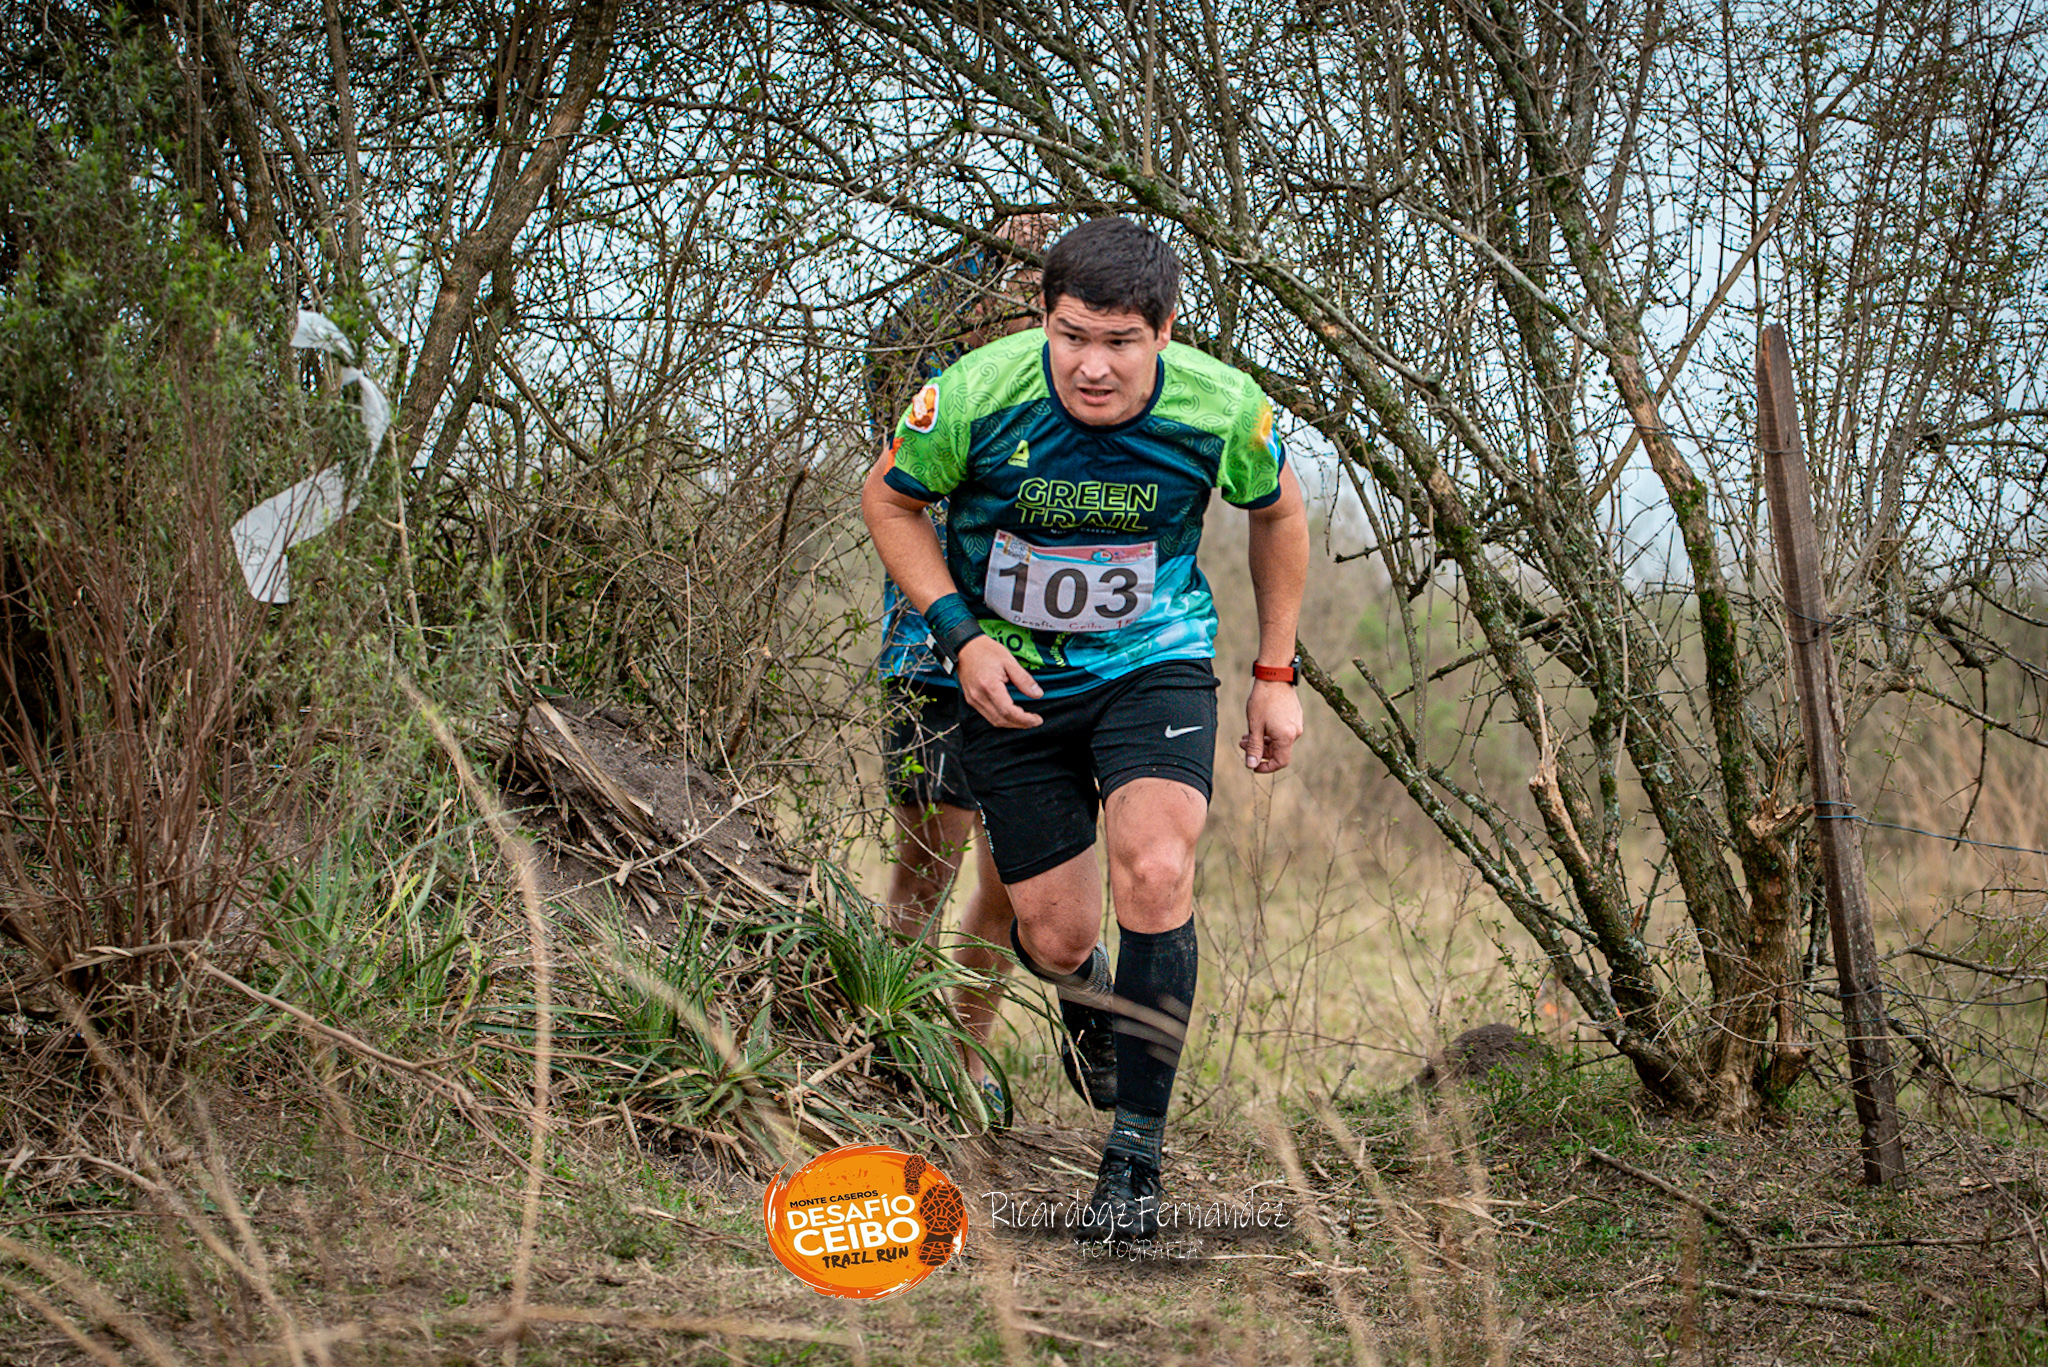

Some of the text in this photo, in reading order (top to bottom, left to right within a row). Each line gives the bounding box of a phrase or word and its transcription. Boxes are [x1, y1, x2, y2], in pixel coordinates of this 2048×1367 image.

[1018, 477, 1158, 512] GREEN
[1015, 502, 1148, 532] TRAIL
[999, 561, 1139, 620] 103
